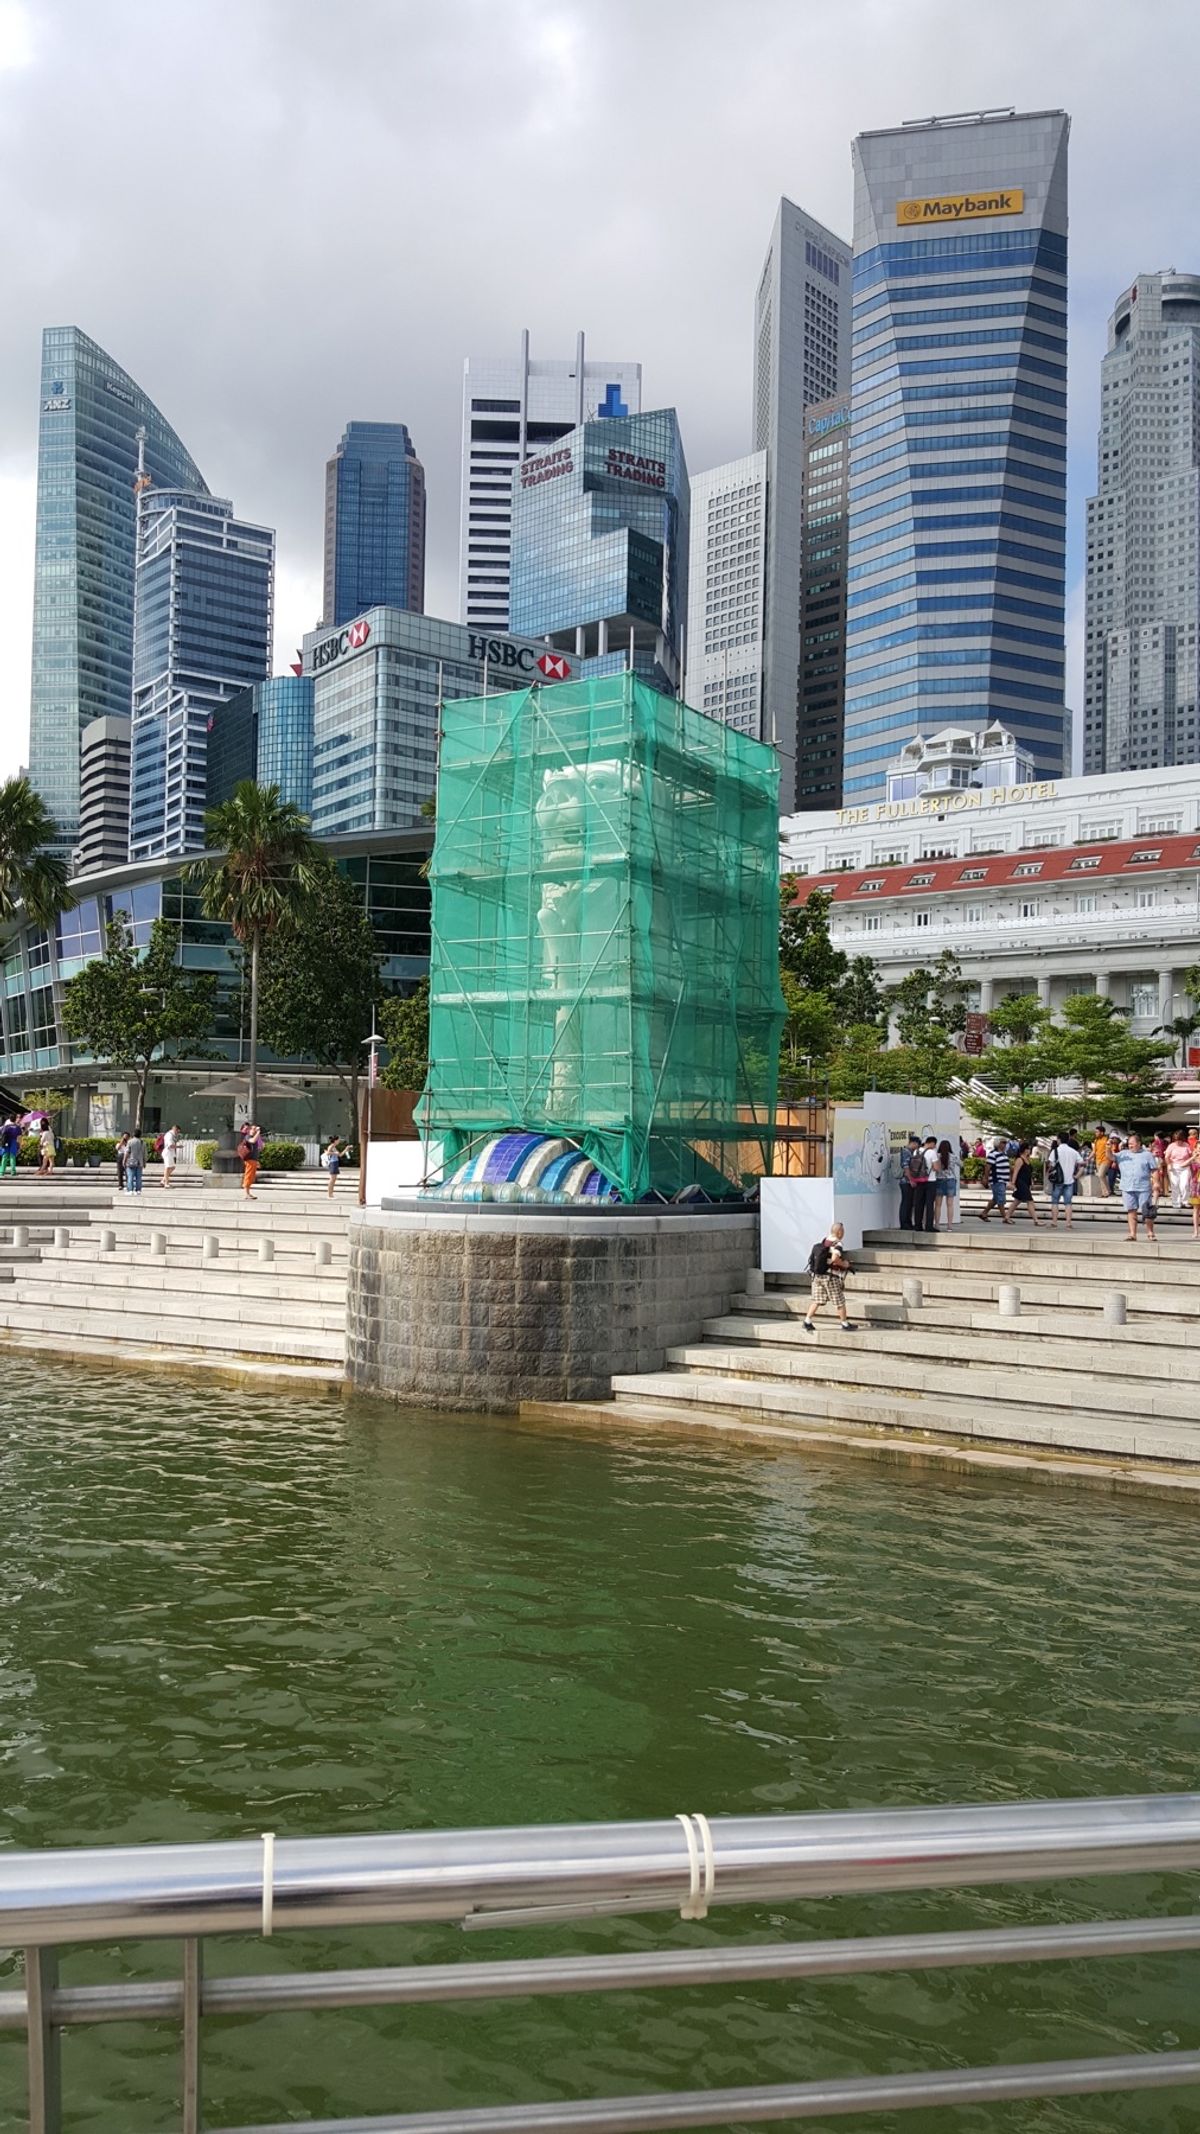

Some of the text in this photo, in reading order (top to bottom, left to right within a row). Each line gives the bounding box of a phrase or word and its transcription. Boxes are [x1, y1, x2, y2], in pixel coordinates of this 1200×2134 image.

[923, 194, 1012, 217] Maybank
[44, 399, 71, 411] ANZ
[520, 461, 574, 489] TRADING
[521, 448, 571, 476] STRAITS
[605, 461, 666, 488] TRADING
[608, 449, 666, 474] STRAITS
[312, 630, 349, 670] HSBC
[468, 634, 534, 671] HSBC
[835, 782, 1059, 825] THE FULLERTON HOTEL
